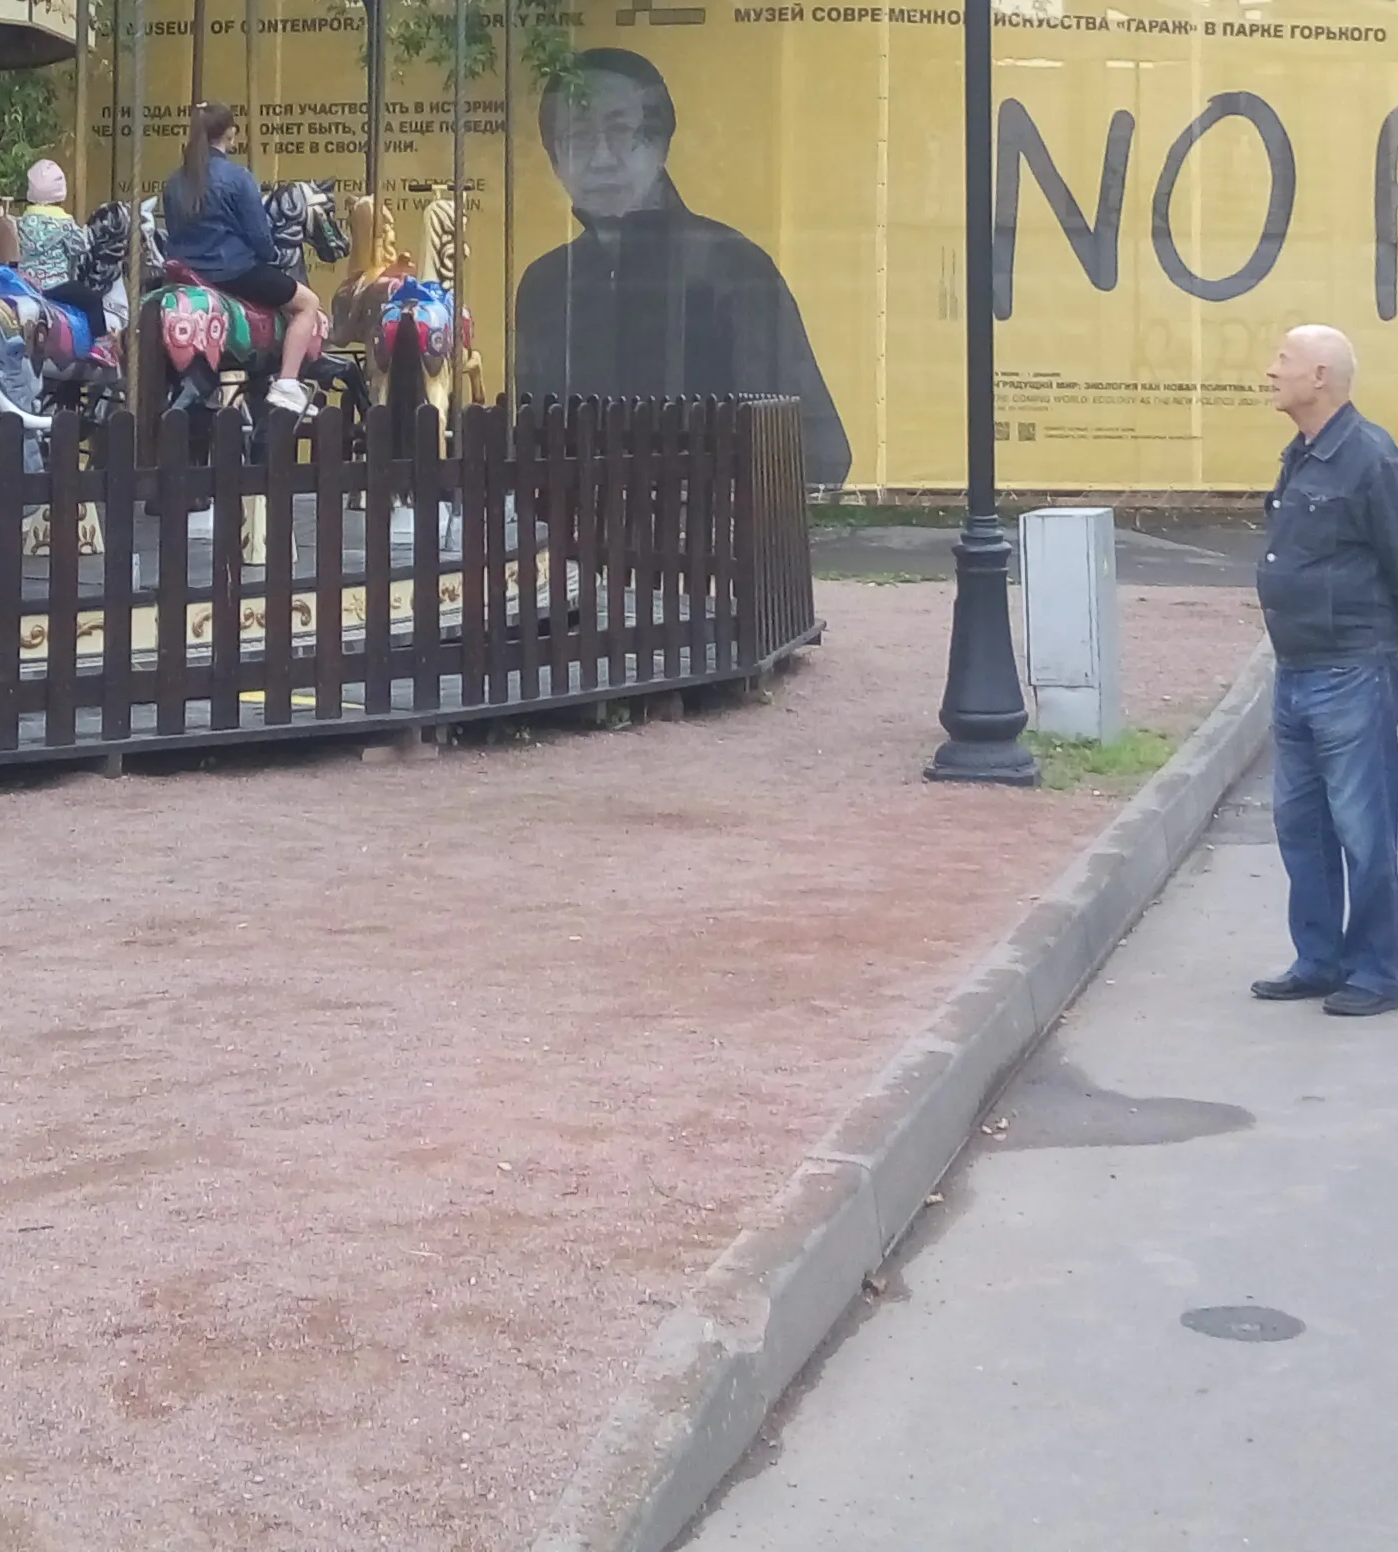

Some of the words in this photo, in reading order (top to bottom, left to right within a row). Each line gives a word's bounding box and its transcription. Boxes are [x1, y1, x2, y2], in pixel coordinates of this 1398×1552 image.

[210, 20, 235, 35] OF
[734, 3, 805, 23] МУЗЕЙ
[994, 11, 1110, 31] ИСКУССТВА
[1204, 21, 1216, 36] В
[1222, 21, 1284, 39] ПАРКЕ
[1289, 24, 1387, 43] ГОРЬКОГО
[414, 102, 424, 114] В
[308, 121, 357, 137] БЫТЬ,
[399, 120, 435, 136] ЕЩЕ
[275, 140, 305, 154] ВСЕ
[309, 140, 320, 154] В
[384, 140, 419, 154] УКИ.
[990, 91, 1296, 322] NO
